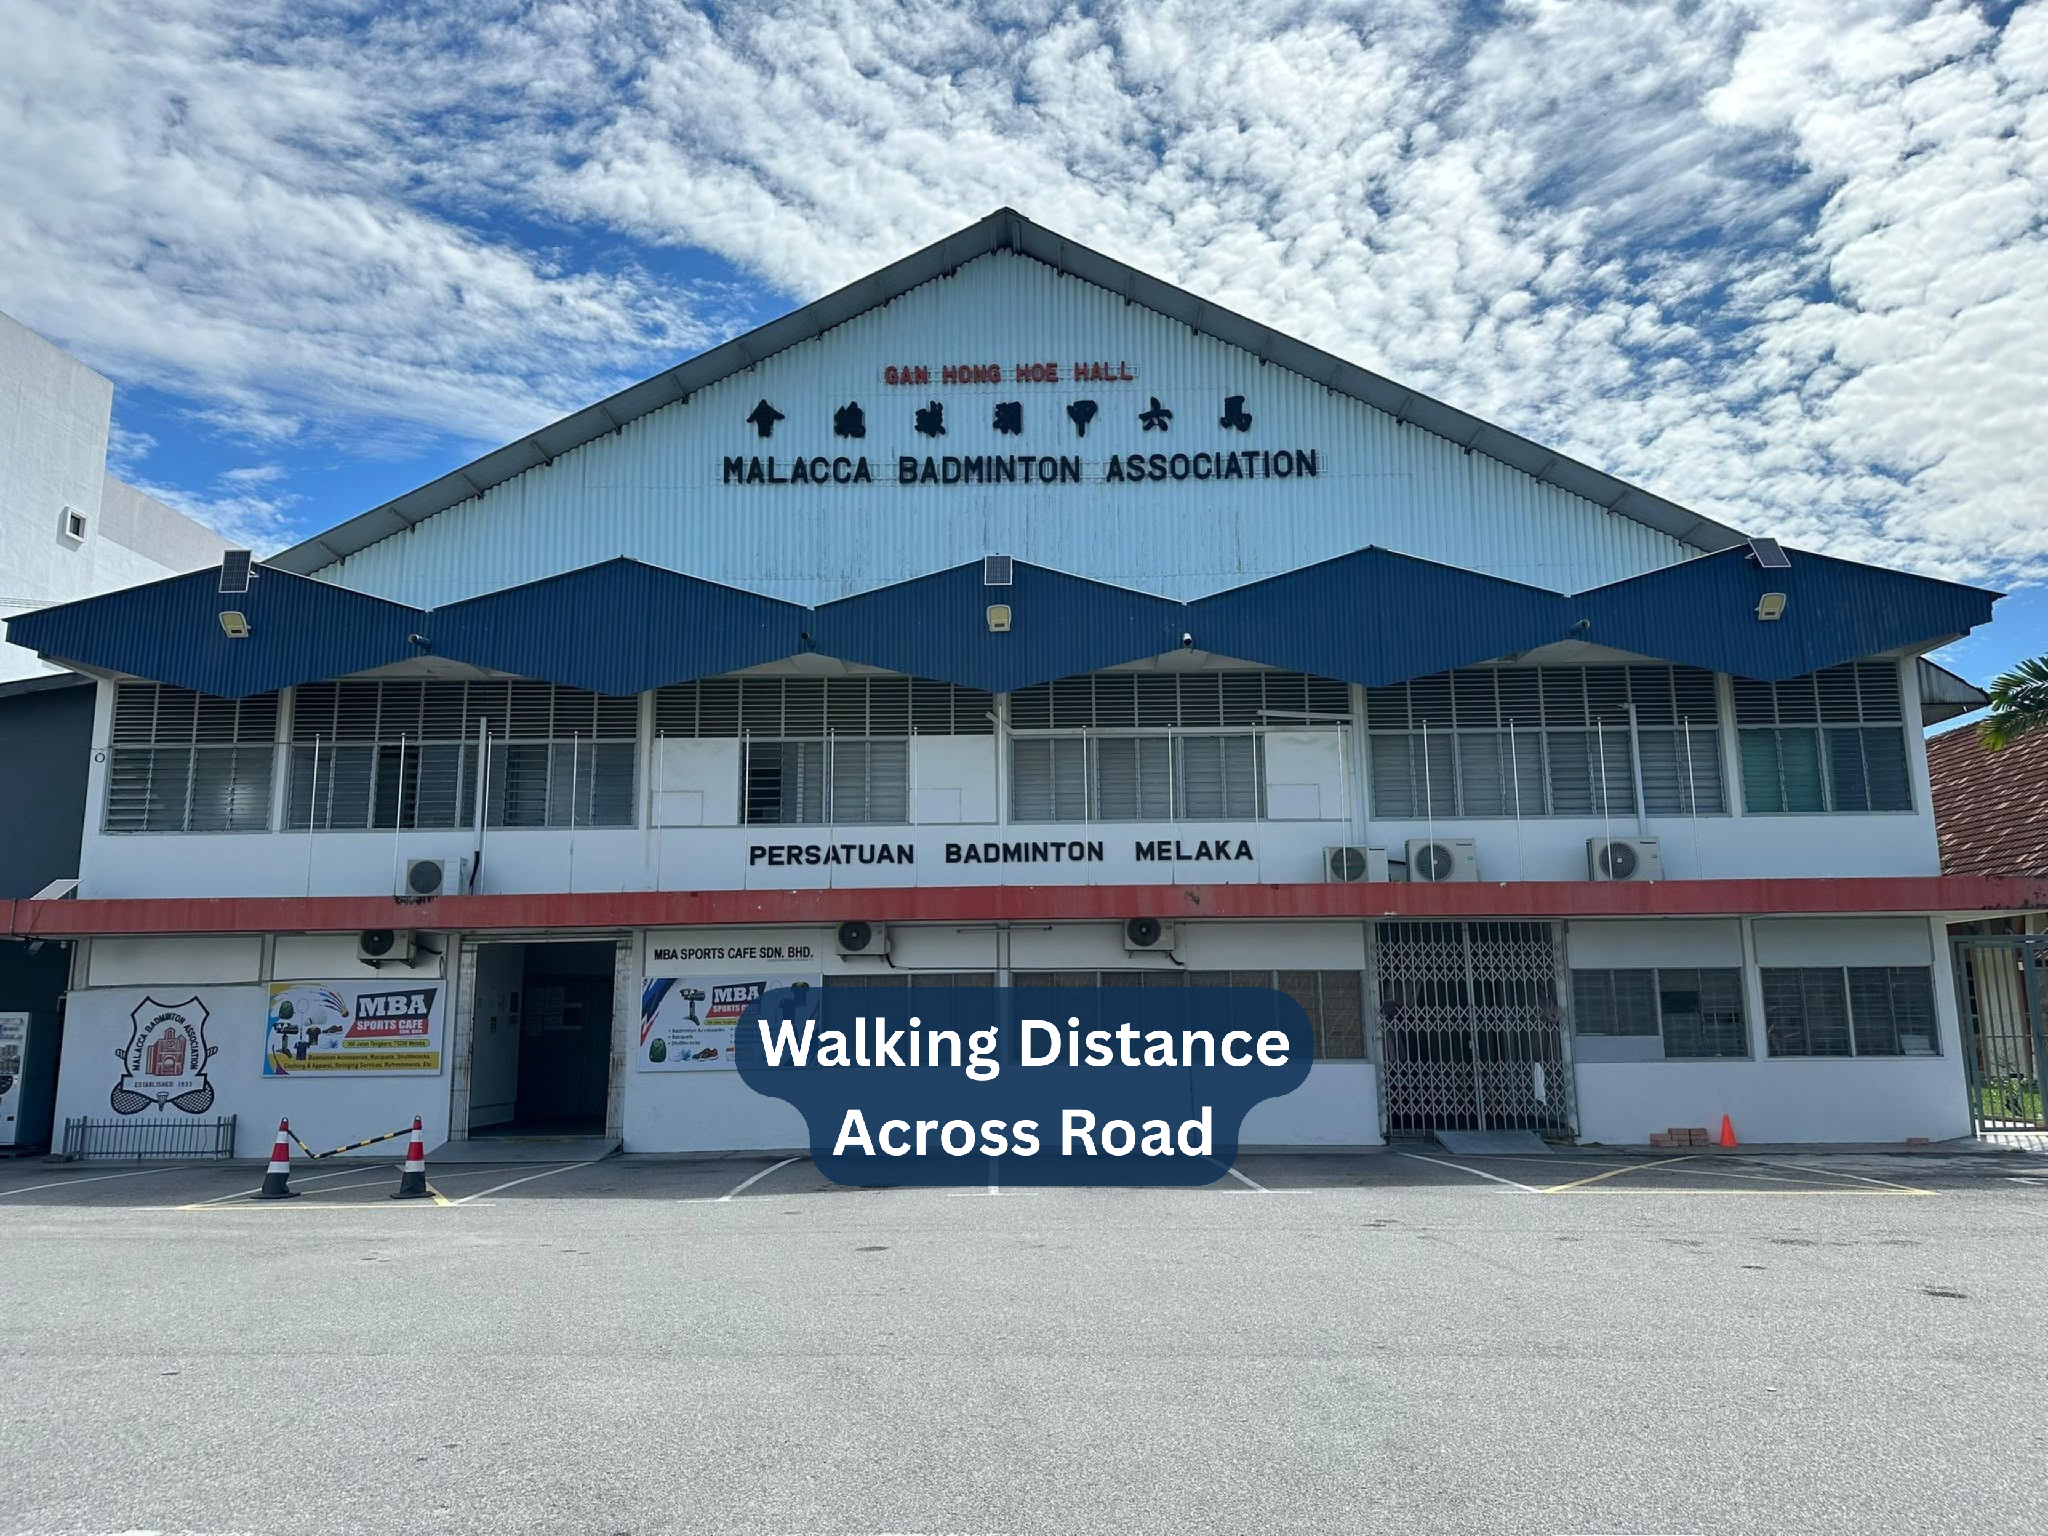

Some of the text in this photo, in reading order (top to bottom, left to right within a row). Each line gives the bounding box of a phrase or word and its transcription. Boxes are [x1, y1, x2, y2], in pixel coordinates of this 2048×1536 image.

[885, 361, 1134, 385] GAN HONG HOE HALL
[723, 449, 1318, 485] MALACCA BADMINTON ASSOCIATION
[749, 840, 1254, 866] PERSATUAN BADMINTON MELAKA
[654, 945, 814, 960] MBA SPORTS CAFE SDN. BHD.
[713, 985, 760, 1002] MBA
[358, 994, 428, 1018] MBA
[712, 1004, 741, 1013] SPORTS
[356, 1019, 424, 1031] SPORTS CAFE
[132, 1012, 199, 1072] MALACCA BADMINTON ASSOCIATION
